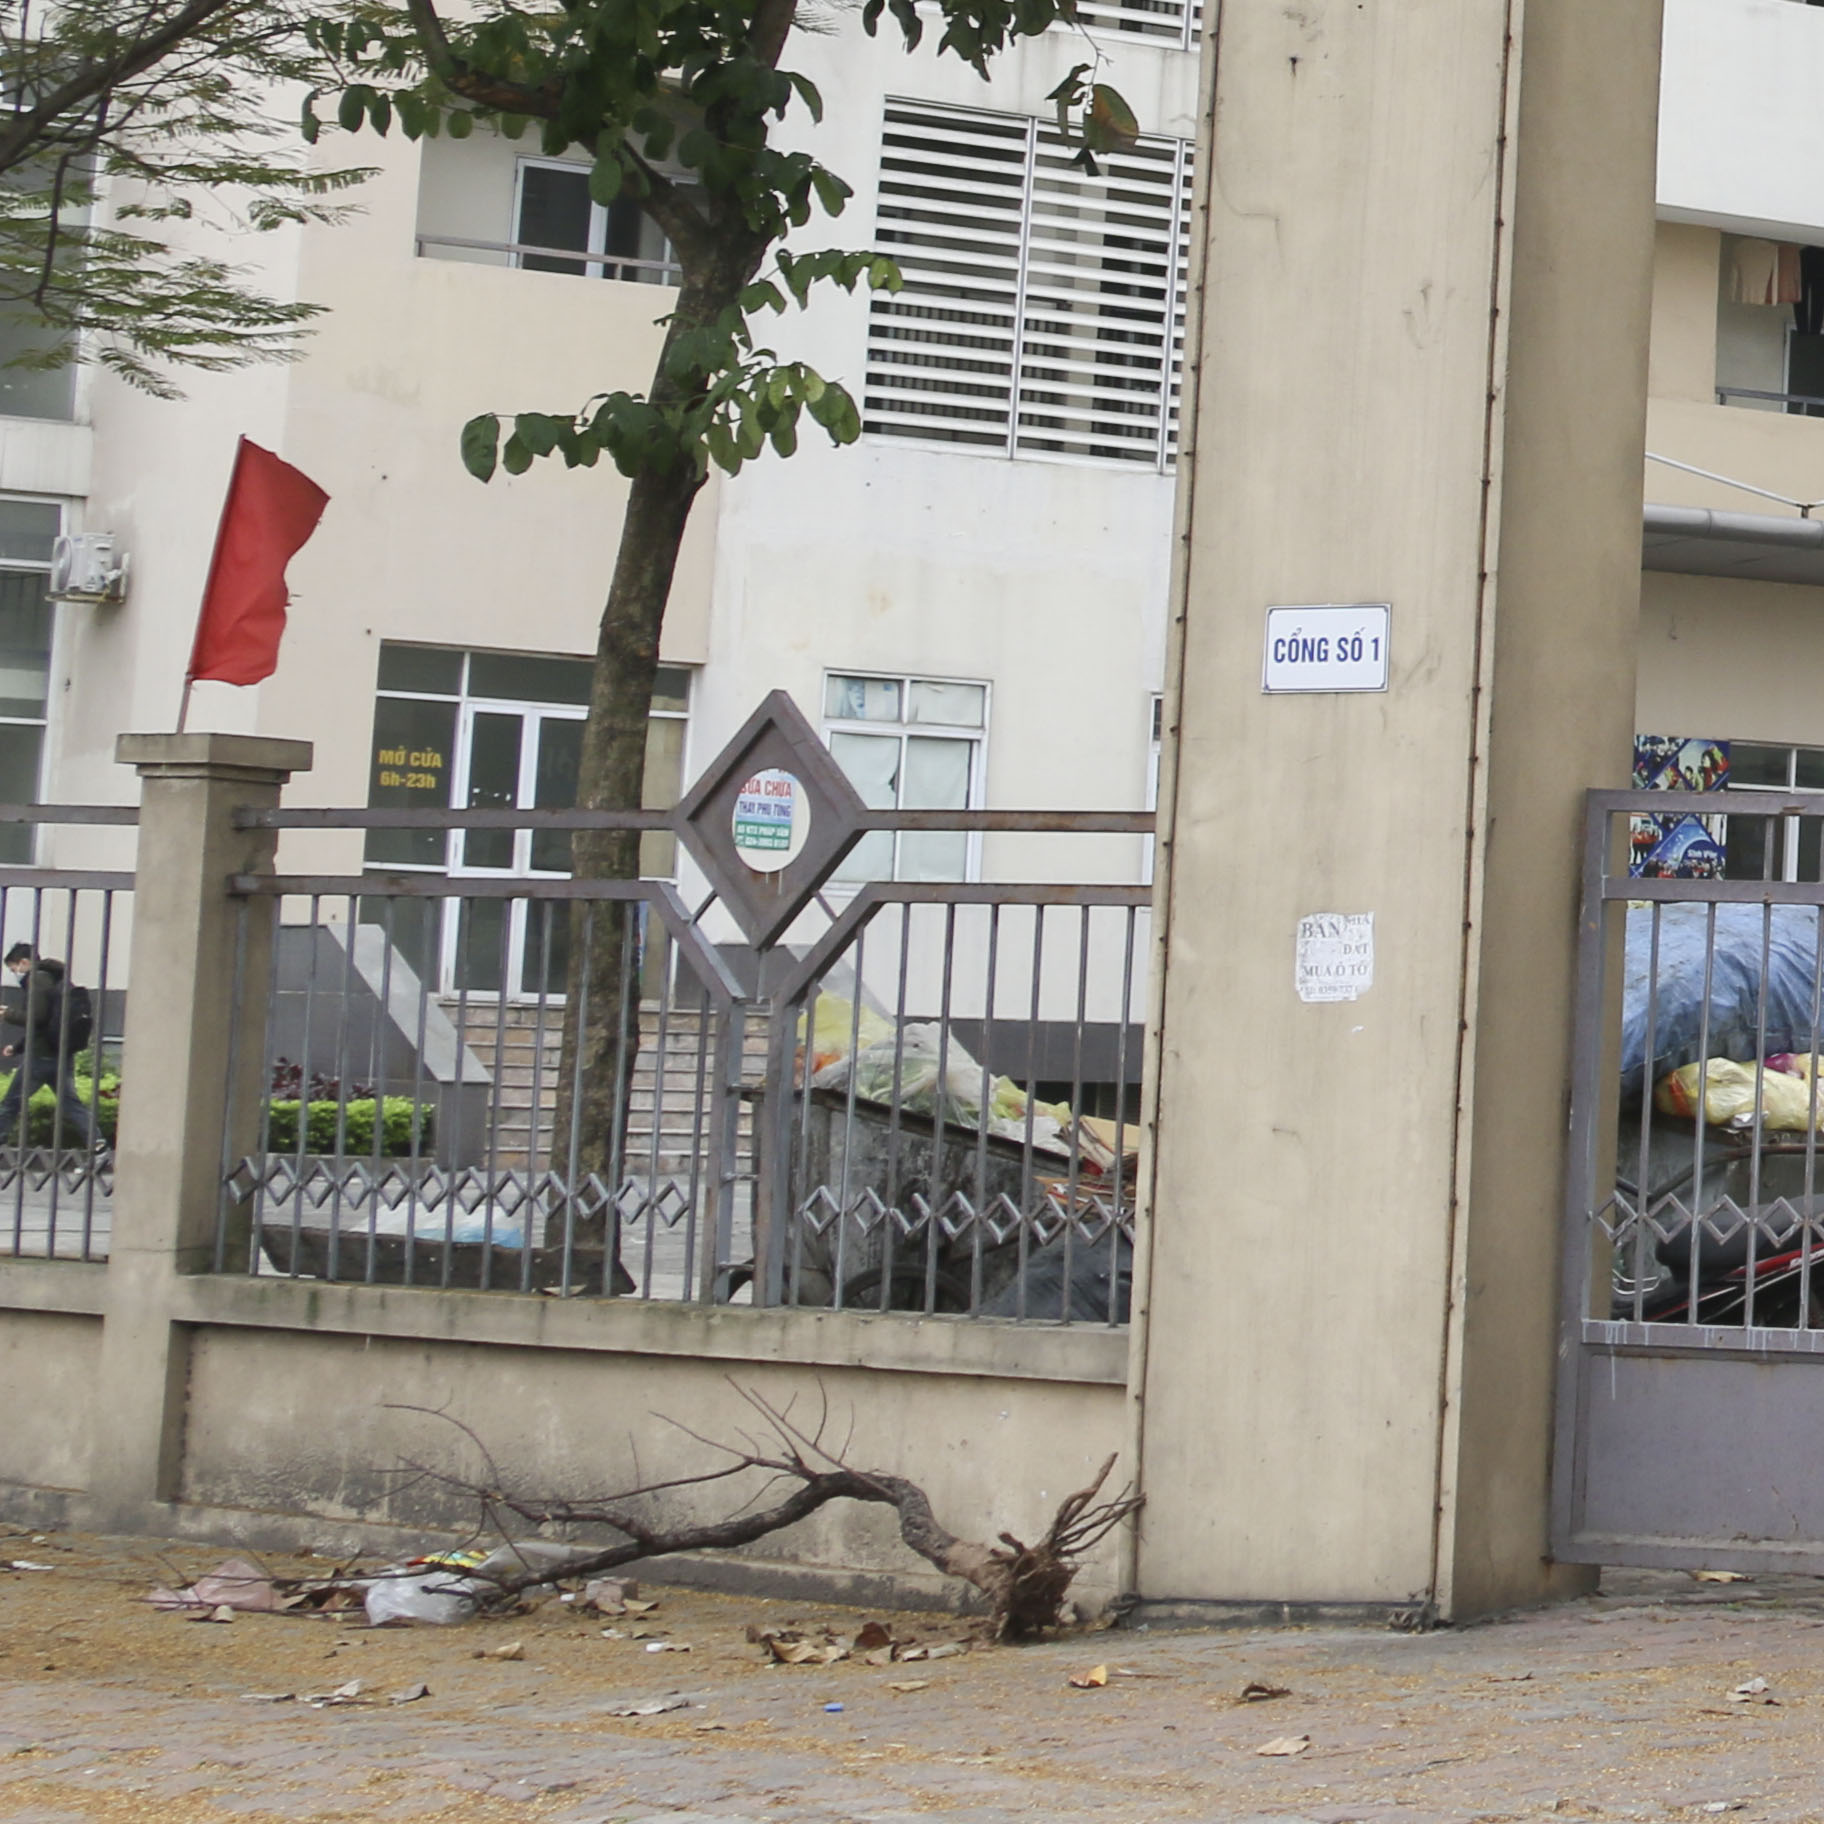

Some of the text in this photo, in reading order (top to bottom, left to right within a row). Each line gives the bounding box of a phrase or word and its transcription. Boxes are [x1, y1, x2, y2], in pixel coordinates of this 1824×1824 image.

[1273, 627, 1381, 664] CỔNG SỐ 1
[378, 745, 443, 769] MỞ CỬA
[379, 771, 437, 789] 6h-23h
